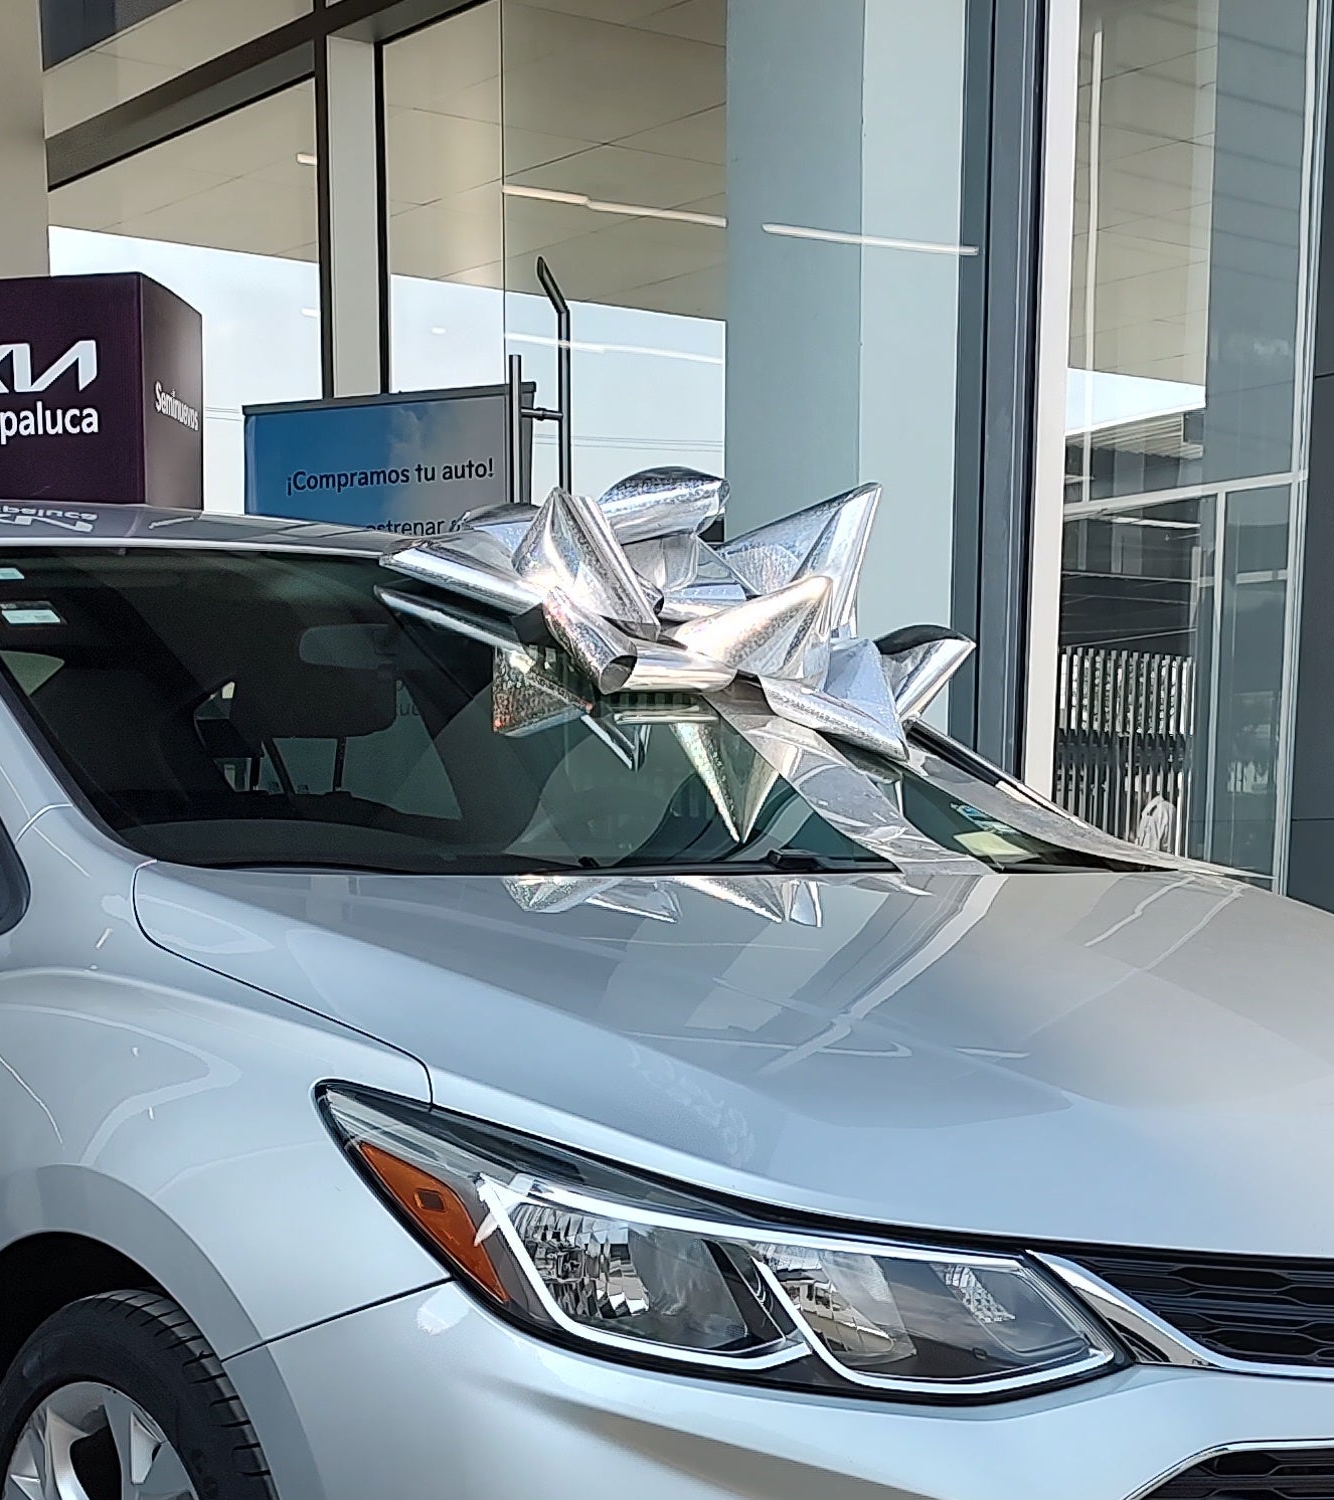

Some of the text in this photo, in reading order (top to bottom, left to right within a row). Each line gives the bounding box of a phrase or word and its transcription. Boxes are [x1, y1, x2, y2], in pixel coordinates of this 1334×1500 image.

[155, 380, 199, 431] Seminuevos
[286, 458, 495, 496] ¡Compramos tu auto!
